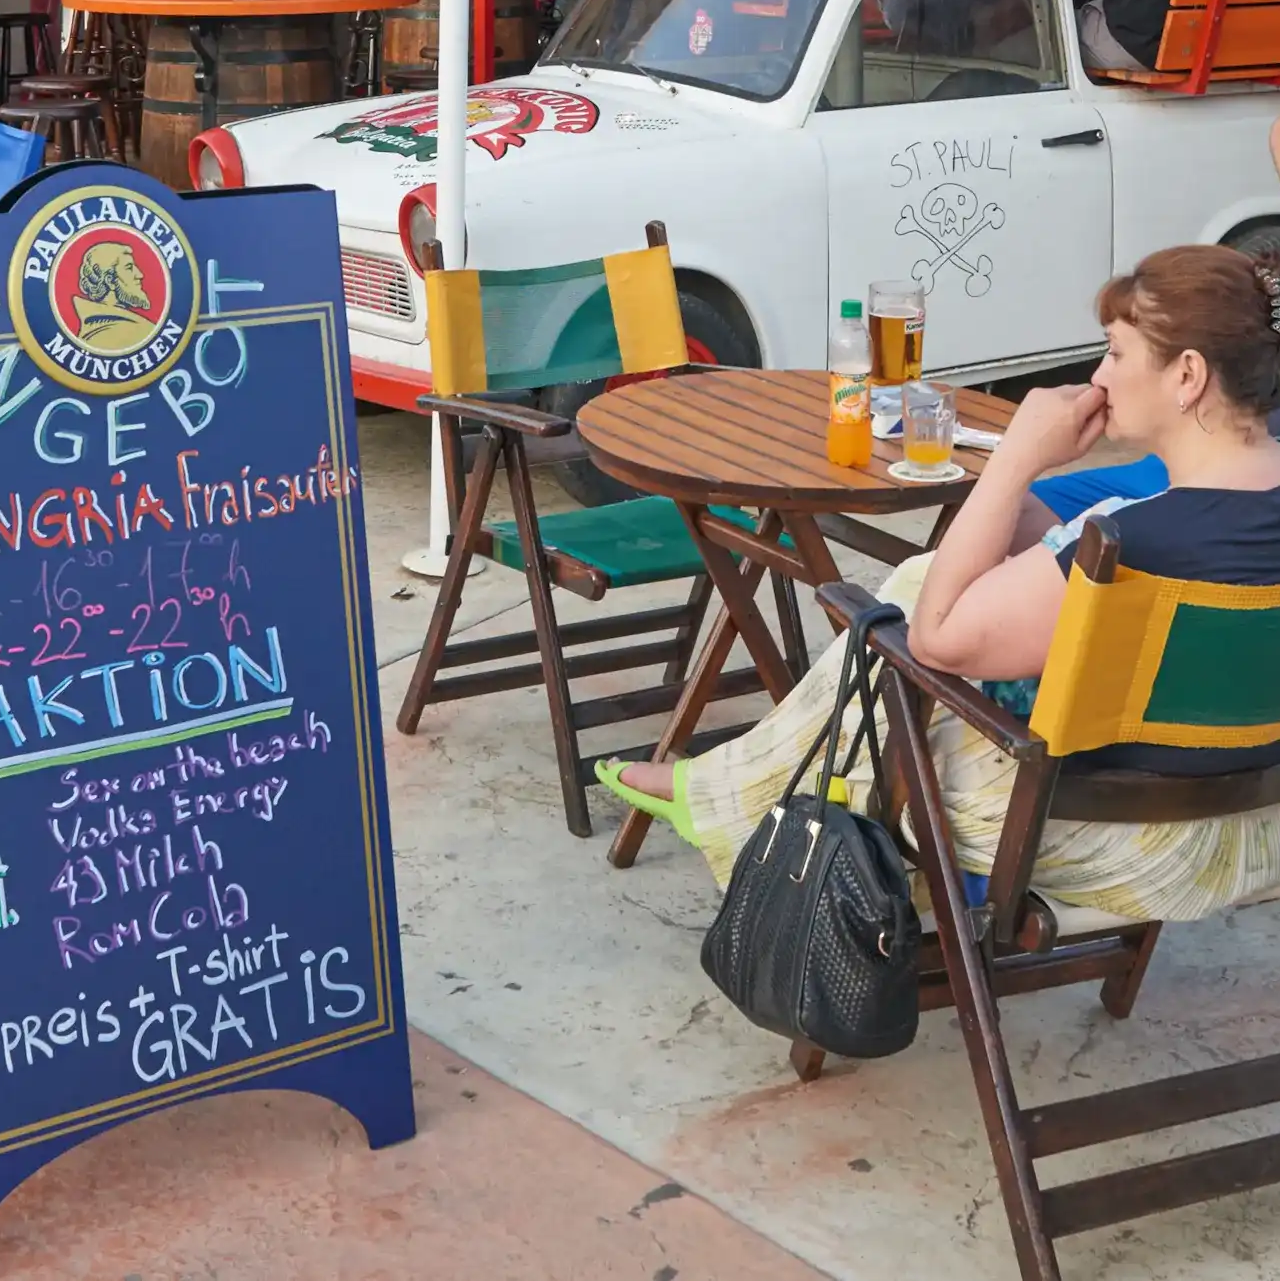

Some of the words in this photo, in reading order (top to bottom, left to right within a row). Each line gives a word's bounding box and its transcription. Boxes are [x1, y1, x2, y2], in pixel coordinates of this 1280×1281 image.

[24, 197, 187, 282] PAULANER
[43, 319, 186, 381] MÜNCHEN
[51, 768, 121, 812] Sex
[166, 743, 226, 785] the
[226, 708, 333, 771] beach
[46, 802, 158, 854] Vodka
[172, 776, 289, 824] Energy
[116, 823, 225, 895] Milch
[148, 873, 250, 941] Cola
[156, 923, 289, 997] T-shirt
